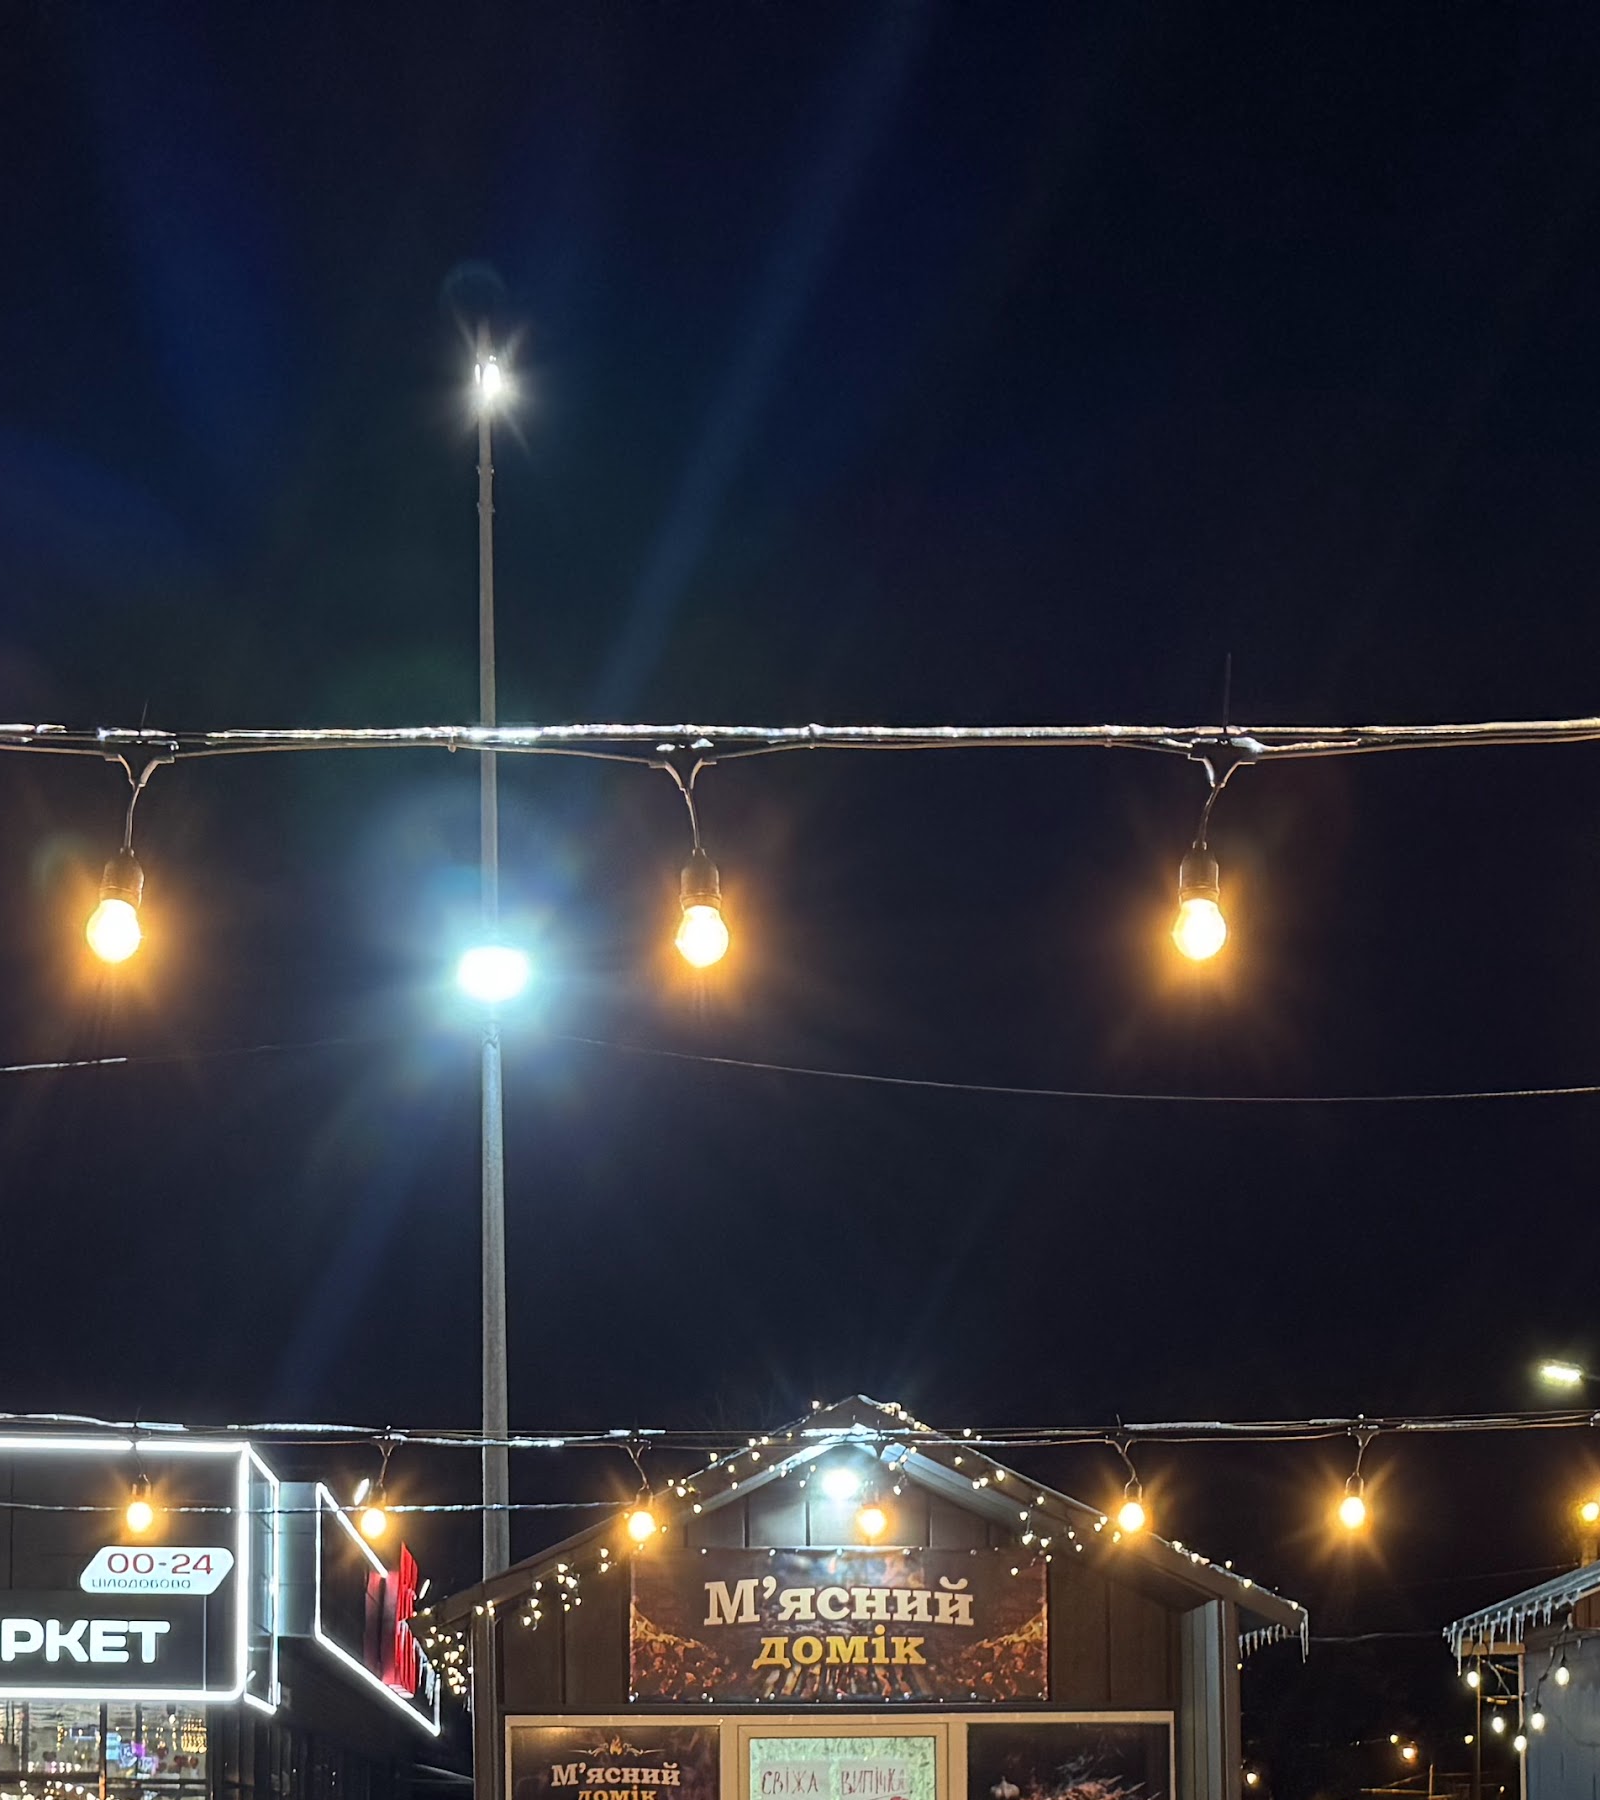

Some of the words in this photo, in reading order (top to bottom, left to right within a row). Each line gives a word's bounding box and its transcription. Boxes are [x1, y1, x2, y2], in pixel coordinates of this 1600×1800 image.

[106, 1553, 214, 1575] 00-24
[703, 1575, 975, 1627] М'ясний
[751, 1624, 927, 1670] домік
[550, 1762, 681, 1787] М'ясний
[761, 1767, 819, 1795] СВІЖА
[840, 1767, 907, 1796] ВИПІЧКА
